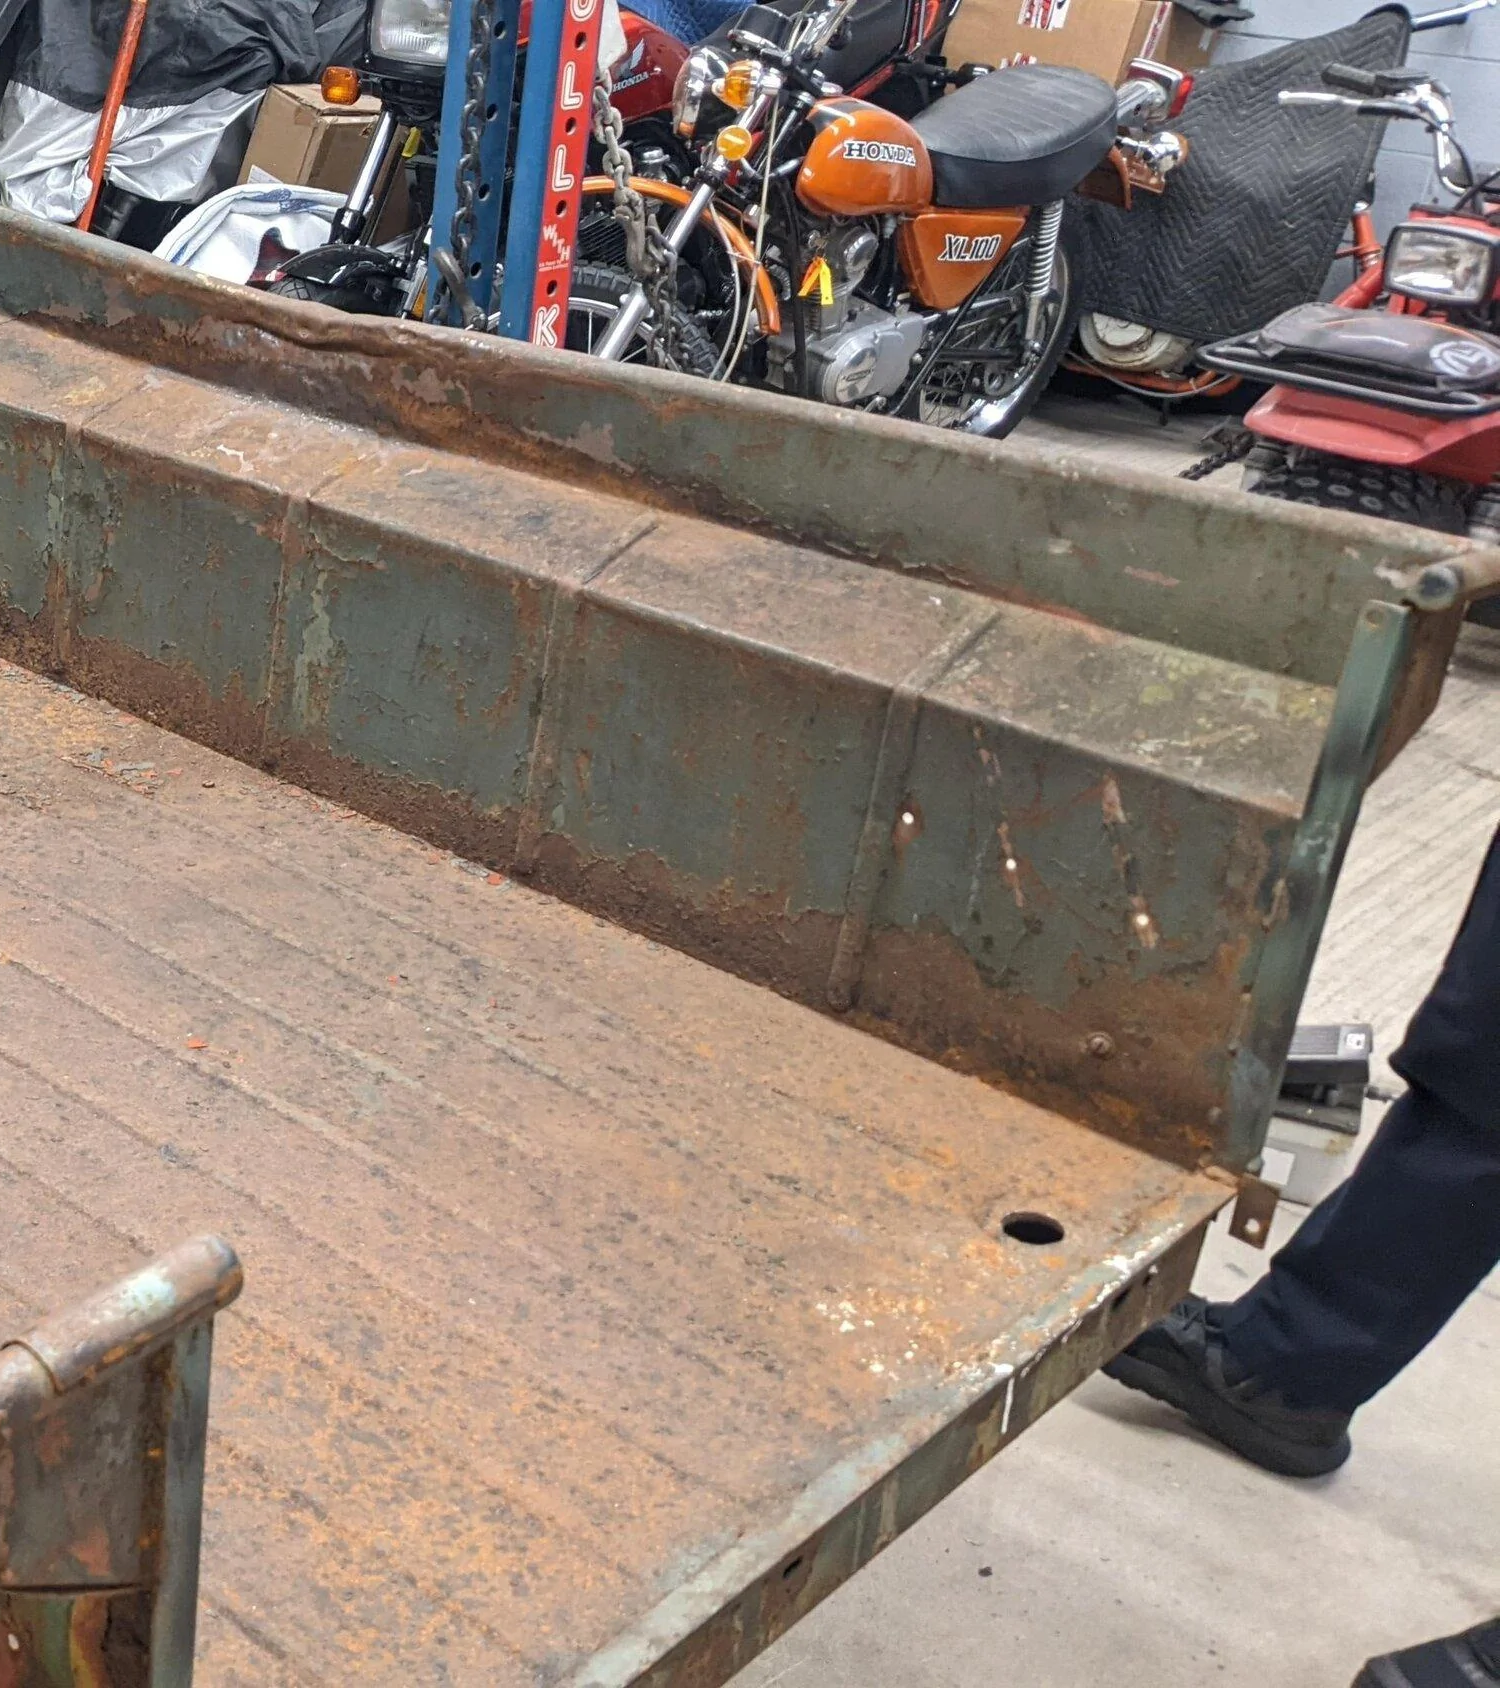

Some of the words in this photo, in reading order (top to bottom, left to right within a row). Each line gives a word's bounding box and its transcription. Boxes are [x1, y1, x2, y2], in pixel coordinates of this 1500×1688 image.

[612, 71, 649, 92] HONDA
[843, 140, 916, 167] HONDA
[542, 224, 570, 261] WITH
[937, 234, 1002, 261] XL100
